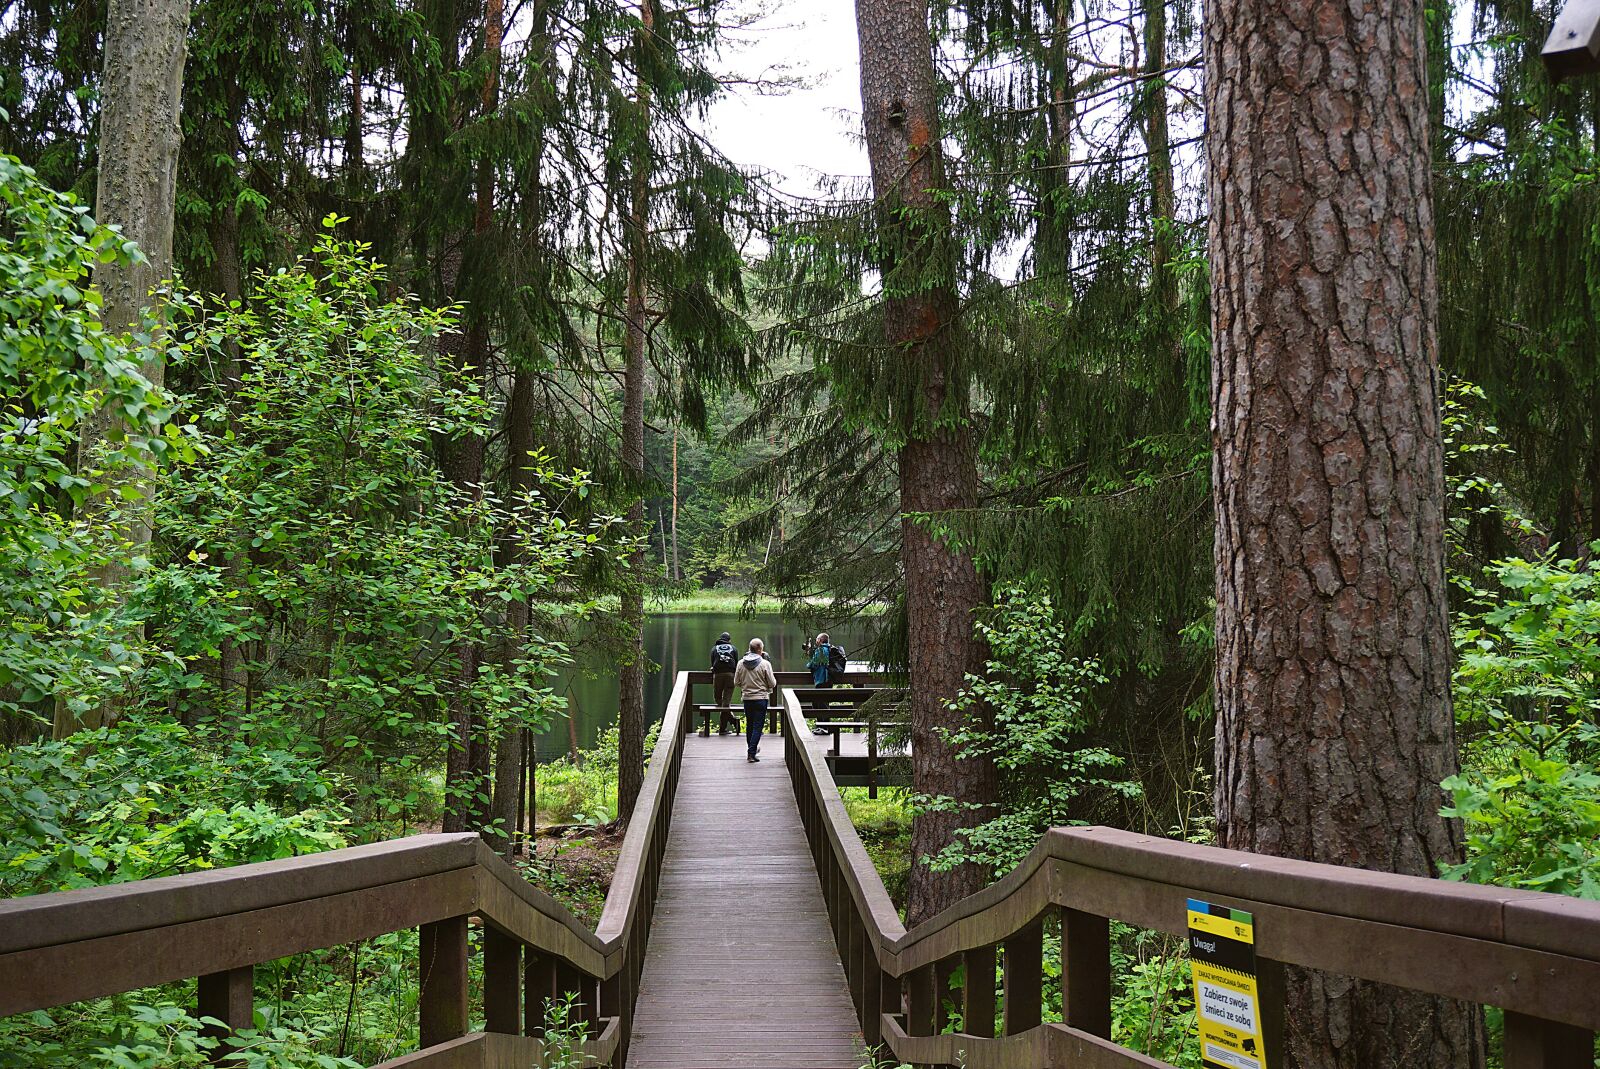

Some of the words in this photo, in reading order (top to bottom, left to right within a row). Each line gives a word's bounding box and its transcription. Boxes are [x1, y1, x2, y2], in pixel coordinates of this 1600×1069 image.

[1193, 936, 1216, 953] Uwaga!
[1204, 986, 1228, 1004] Zabierz
[1229, 997, 1248, 1011] swoje
[1205, 1002, 1226, 1018] śmieci
[1226, 1011, 1234, 1021] ze
[1235, 1013, 1251, 1029] sobą
